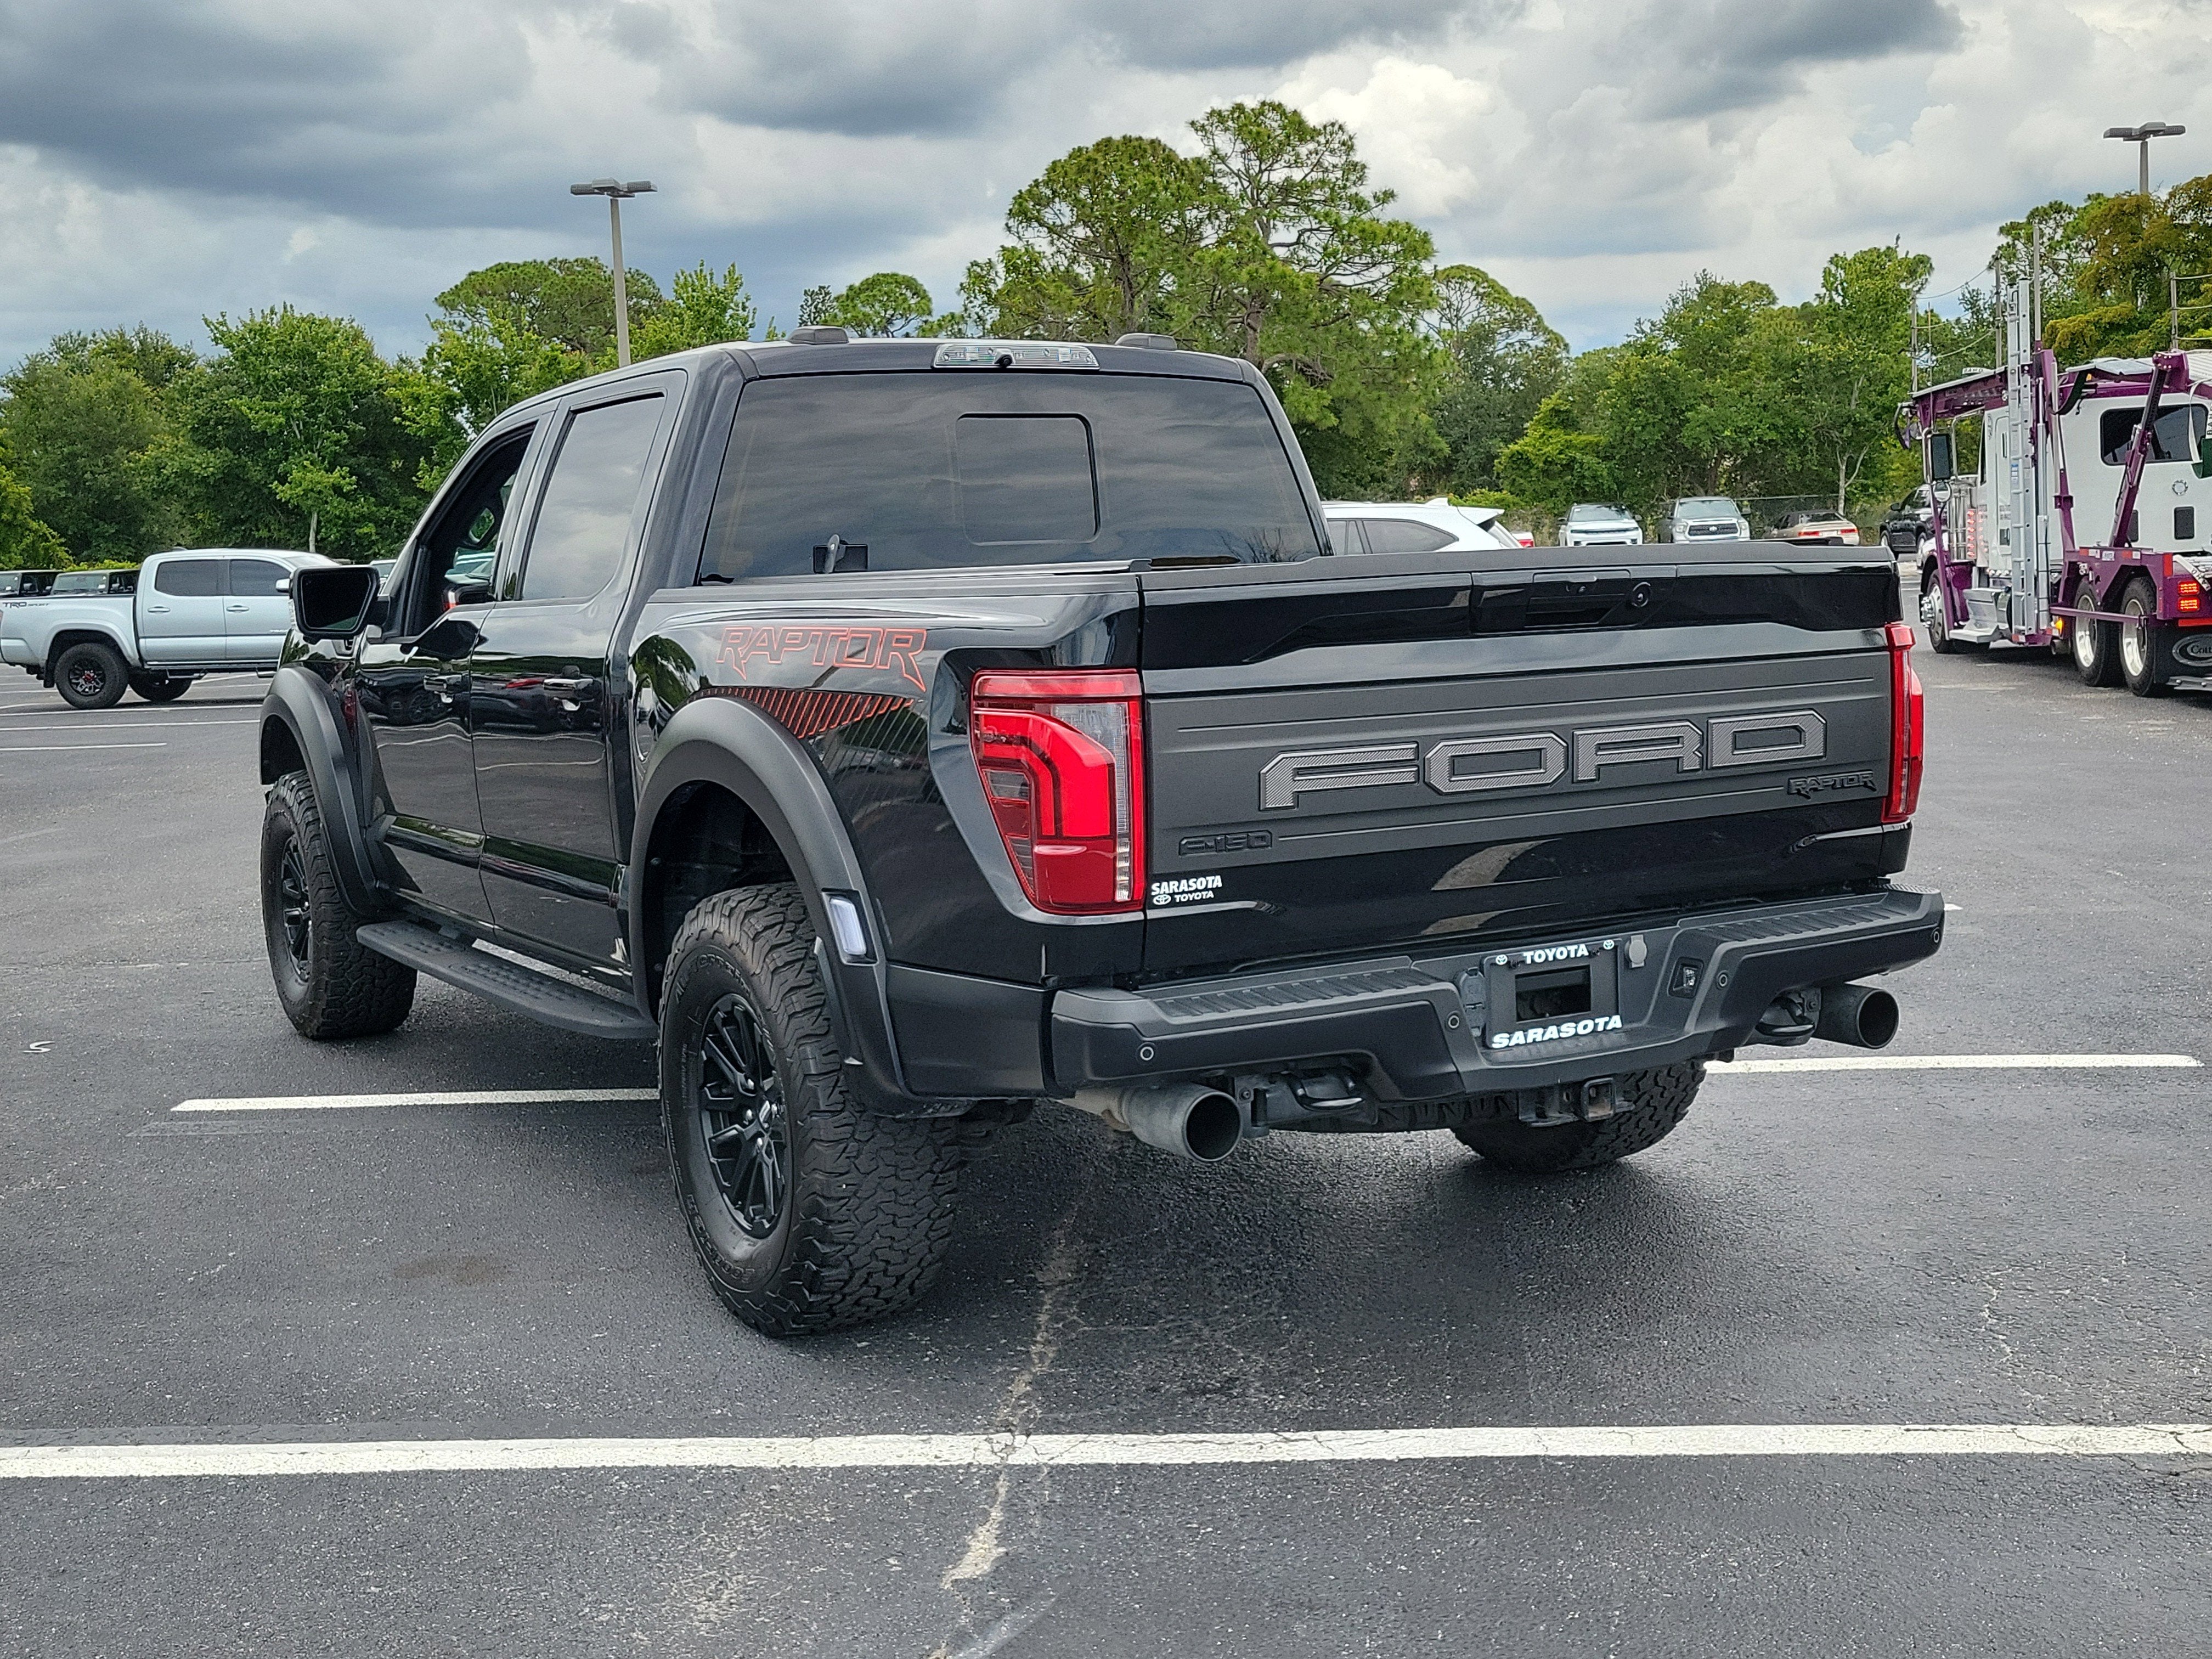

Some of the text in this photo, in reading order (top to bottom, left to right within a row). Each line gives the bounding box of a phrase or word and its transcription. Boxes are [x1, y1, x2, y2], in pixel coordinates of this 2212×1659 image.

[716, 627, 927, 692] RAPTOR
[1260, 709, 1827, 810] FORD
[1787, 769, 1877, 800] RAPTOR
[1151, 875, 1222, 895] SARASOTA
[1175, 890, 1214, 902] TOYOTA
[1523, 944, 1589, 964] TOYOTA
[1492, 1015, 1622, 1048] SARASOTA
